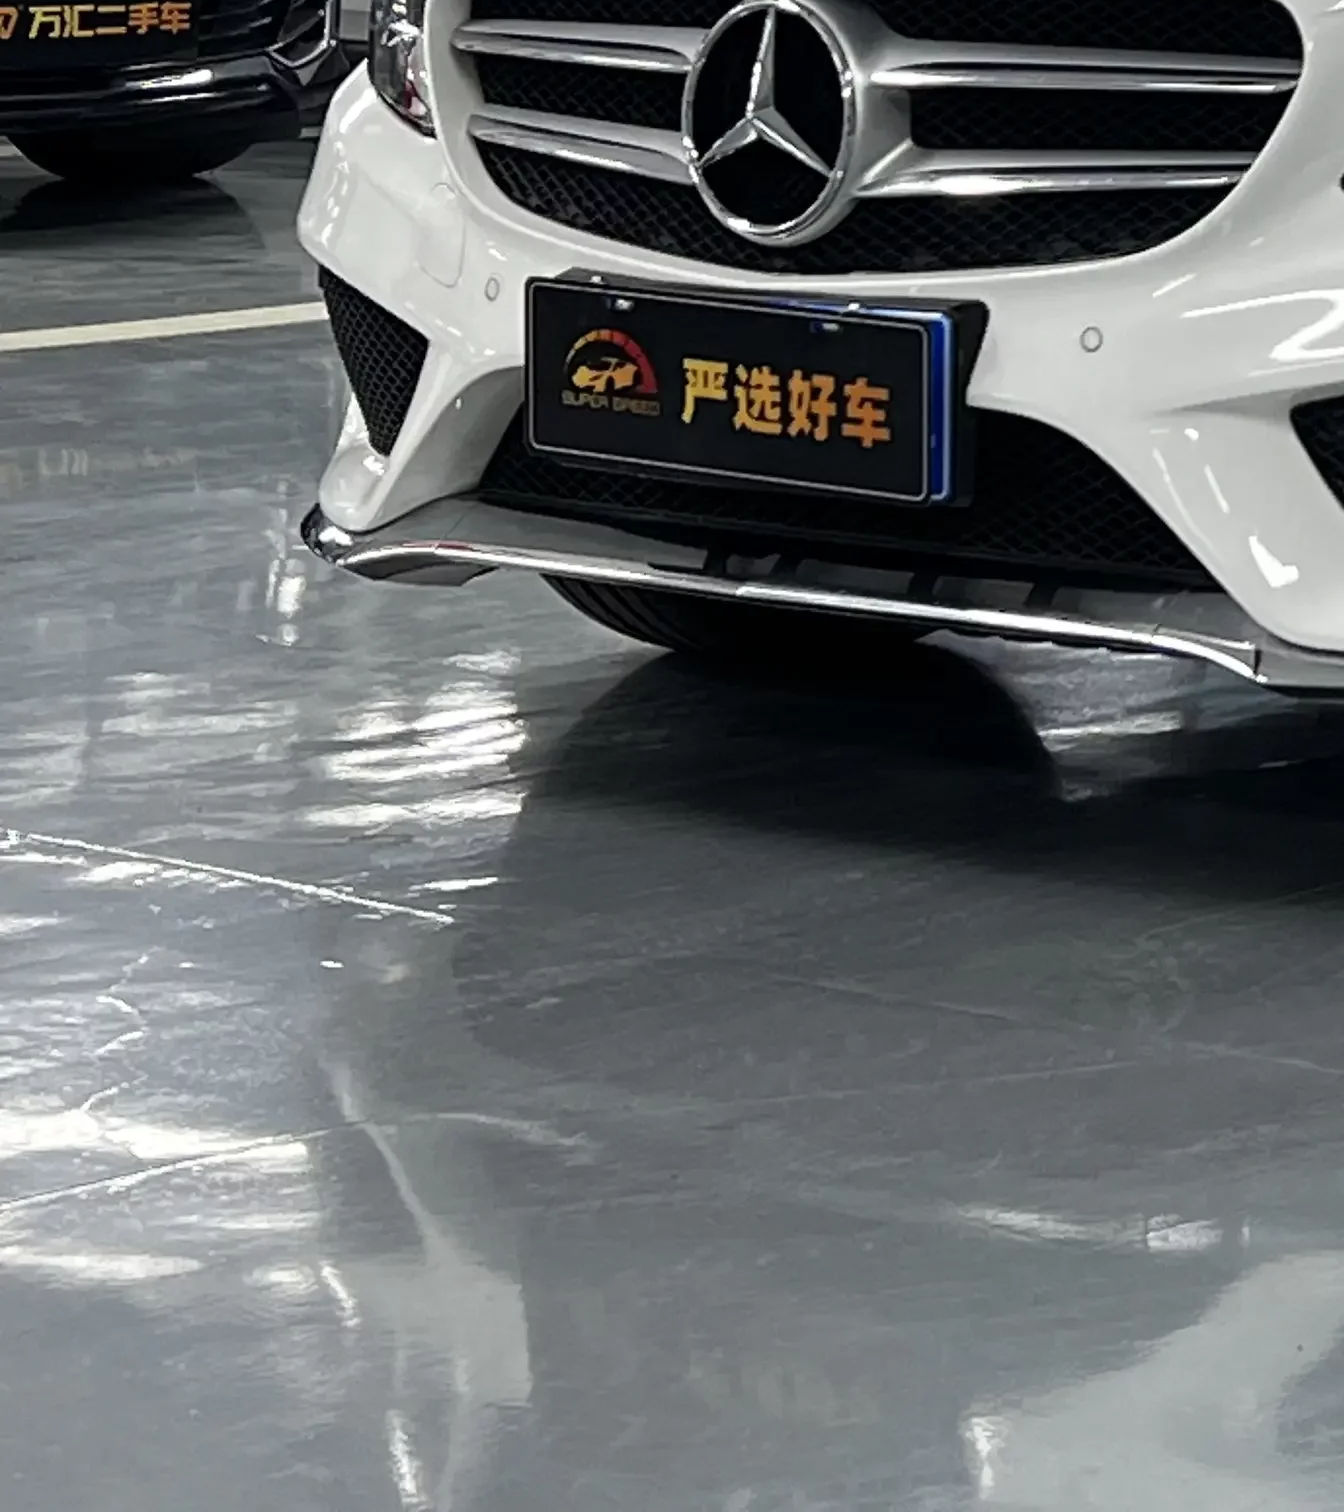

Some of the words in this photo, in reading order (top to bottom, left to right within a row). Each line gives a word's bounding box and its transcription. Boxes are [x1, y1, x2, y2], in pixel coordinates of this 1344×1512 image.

[28, 1, 192, 39] 万汇二手车
[681, 357, 891, 448] 严选好车
